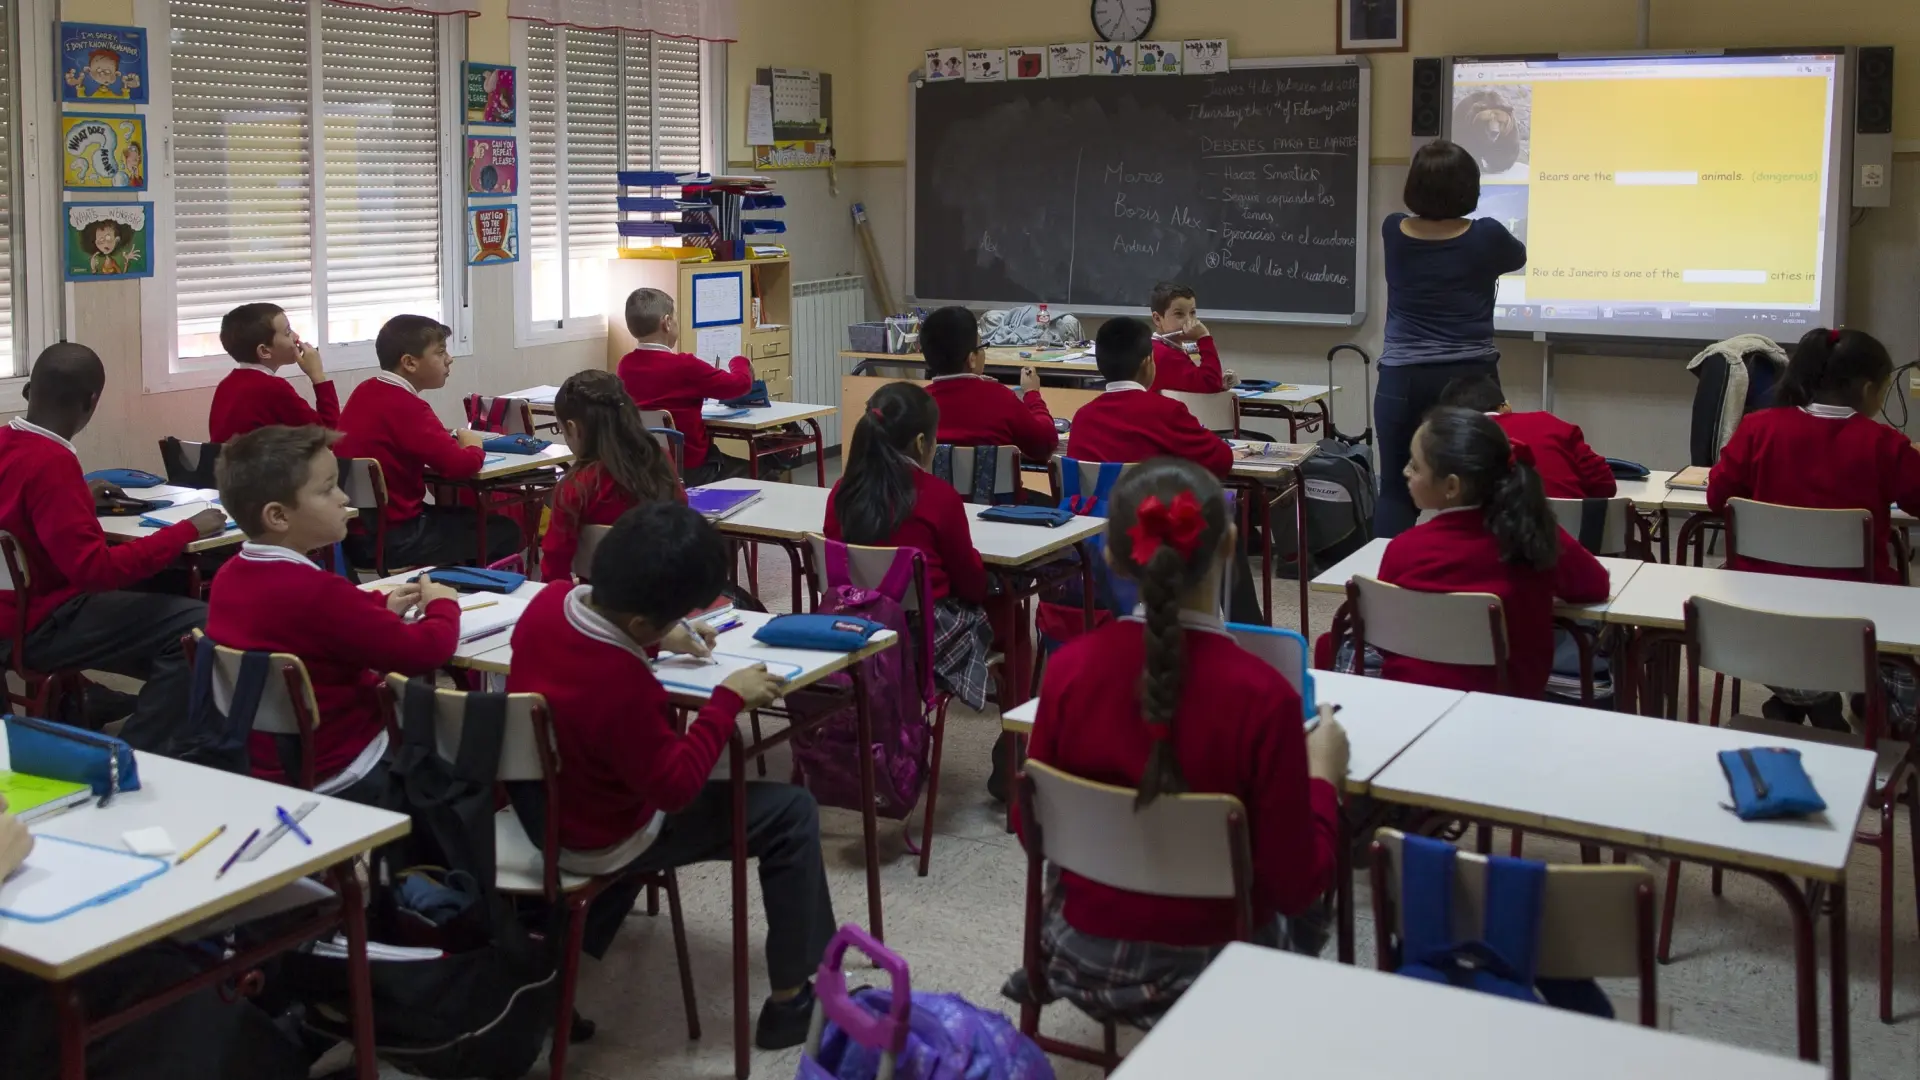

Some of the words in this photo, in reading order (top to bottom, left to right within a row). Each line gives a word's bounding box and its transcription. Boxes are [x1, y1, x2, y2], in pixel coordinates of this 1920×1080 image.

[68, 128, 88, 151] WHAT
[503, 141, 514, 149] YOU
[1200, 135, 1265, 152] DEBERES
[1273, 137, 1303, 150] PARA
[1308, 137, 1321, 150] EL
[492, 157, 516, 166] PLEASE?
[1224, 165, 1256, 180] Hacer
[1263, 163, 1320, 181] Smartick
[1539, 171, 1569, 181] Bears
[1572, 173, 1590, 181] are
[1594, 171, 1612, 181] the
[1701, 171, 1744, 182] animals.
[1752, 170, 1818, 184] (dangerous)
[1222, 187, 1260, 207] Seguir
[1266, 189, 1315, 209] copiando
[1170, 205, 1201, 229] Alex
[1222, 221, 1276, 247] Ejercicios
[1281, 230, 1294, 242] en
[1299, 225, 1310, 245] el
[1222, 248, 1247, 272] Poner
[1249, 255, 1261, 276] al
[1286, 259, 1299, 279] el
[1532, 267, 1549, 277] Rio
[1552, 268, 1565, 277] de
[1568, 268, 1608, 277] Janeiro
[1611, 268, 1621, 278] is
[1645, 268, 1657, 279] of
[1661, 268, 1680, 279] the
[1770, 271, 1802, 281] cities
[1306, 487, 1339, 496] DUNLOP
